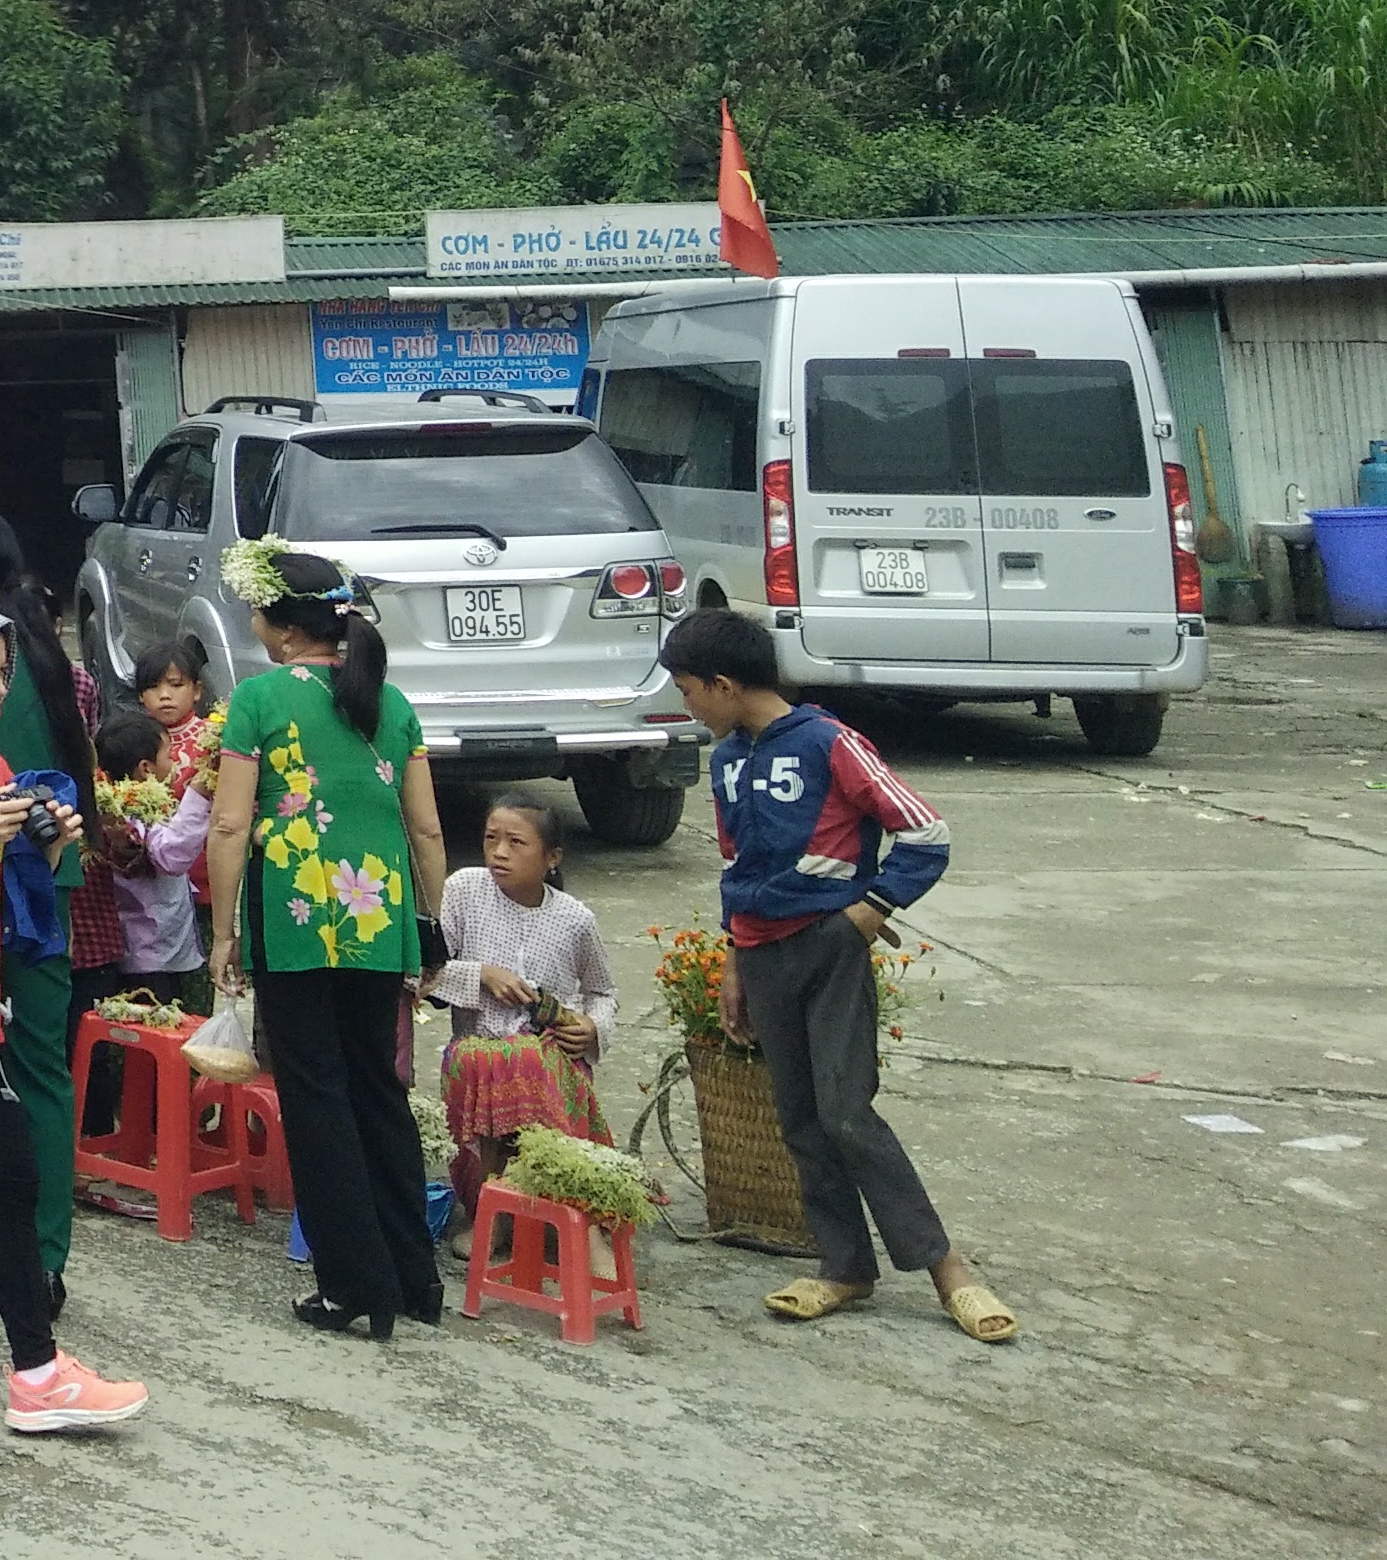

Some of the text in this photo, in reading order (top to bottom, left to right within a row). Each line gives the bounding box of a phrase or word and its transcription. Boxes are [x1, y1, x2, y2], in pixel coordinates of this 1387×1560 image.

[441, 231, 489, 256] CƠM
[512, 224, 562, 254] PHỞ
[584, 221, 628, 252] LẨU
[637, 227, 702, 253] 24/24
[705, 253, 722, 264] 02
[323, 327, 579, 360] CƠM PHỞ LẨU 24/24h
[350, 361, 379, 370] RICE
[390, 360, 443, 370] NOODLE
[453, 358, 505, 368] HOTPOT
[335, 370, 381, 384] CÁC
[384, 369, 436, 383] MÓN
[474, 367, 522, 381] DÂN
[525, 366, 571, 383] TỘC
[825, 507, 894, 517] TRANSIT
[925, 507, 967, 529] 23B
[990, 508, 1060, 530] 00408
[876, 552, 910, 569] 23B
[865, 571, 925, 589] 004.08
[464, 589, 505, 612] 30E
[451, 613, 523, 638] 094.55
